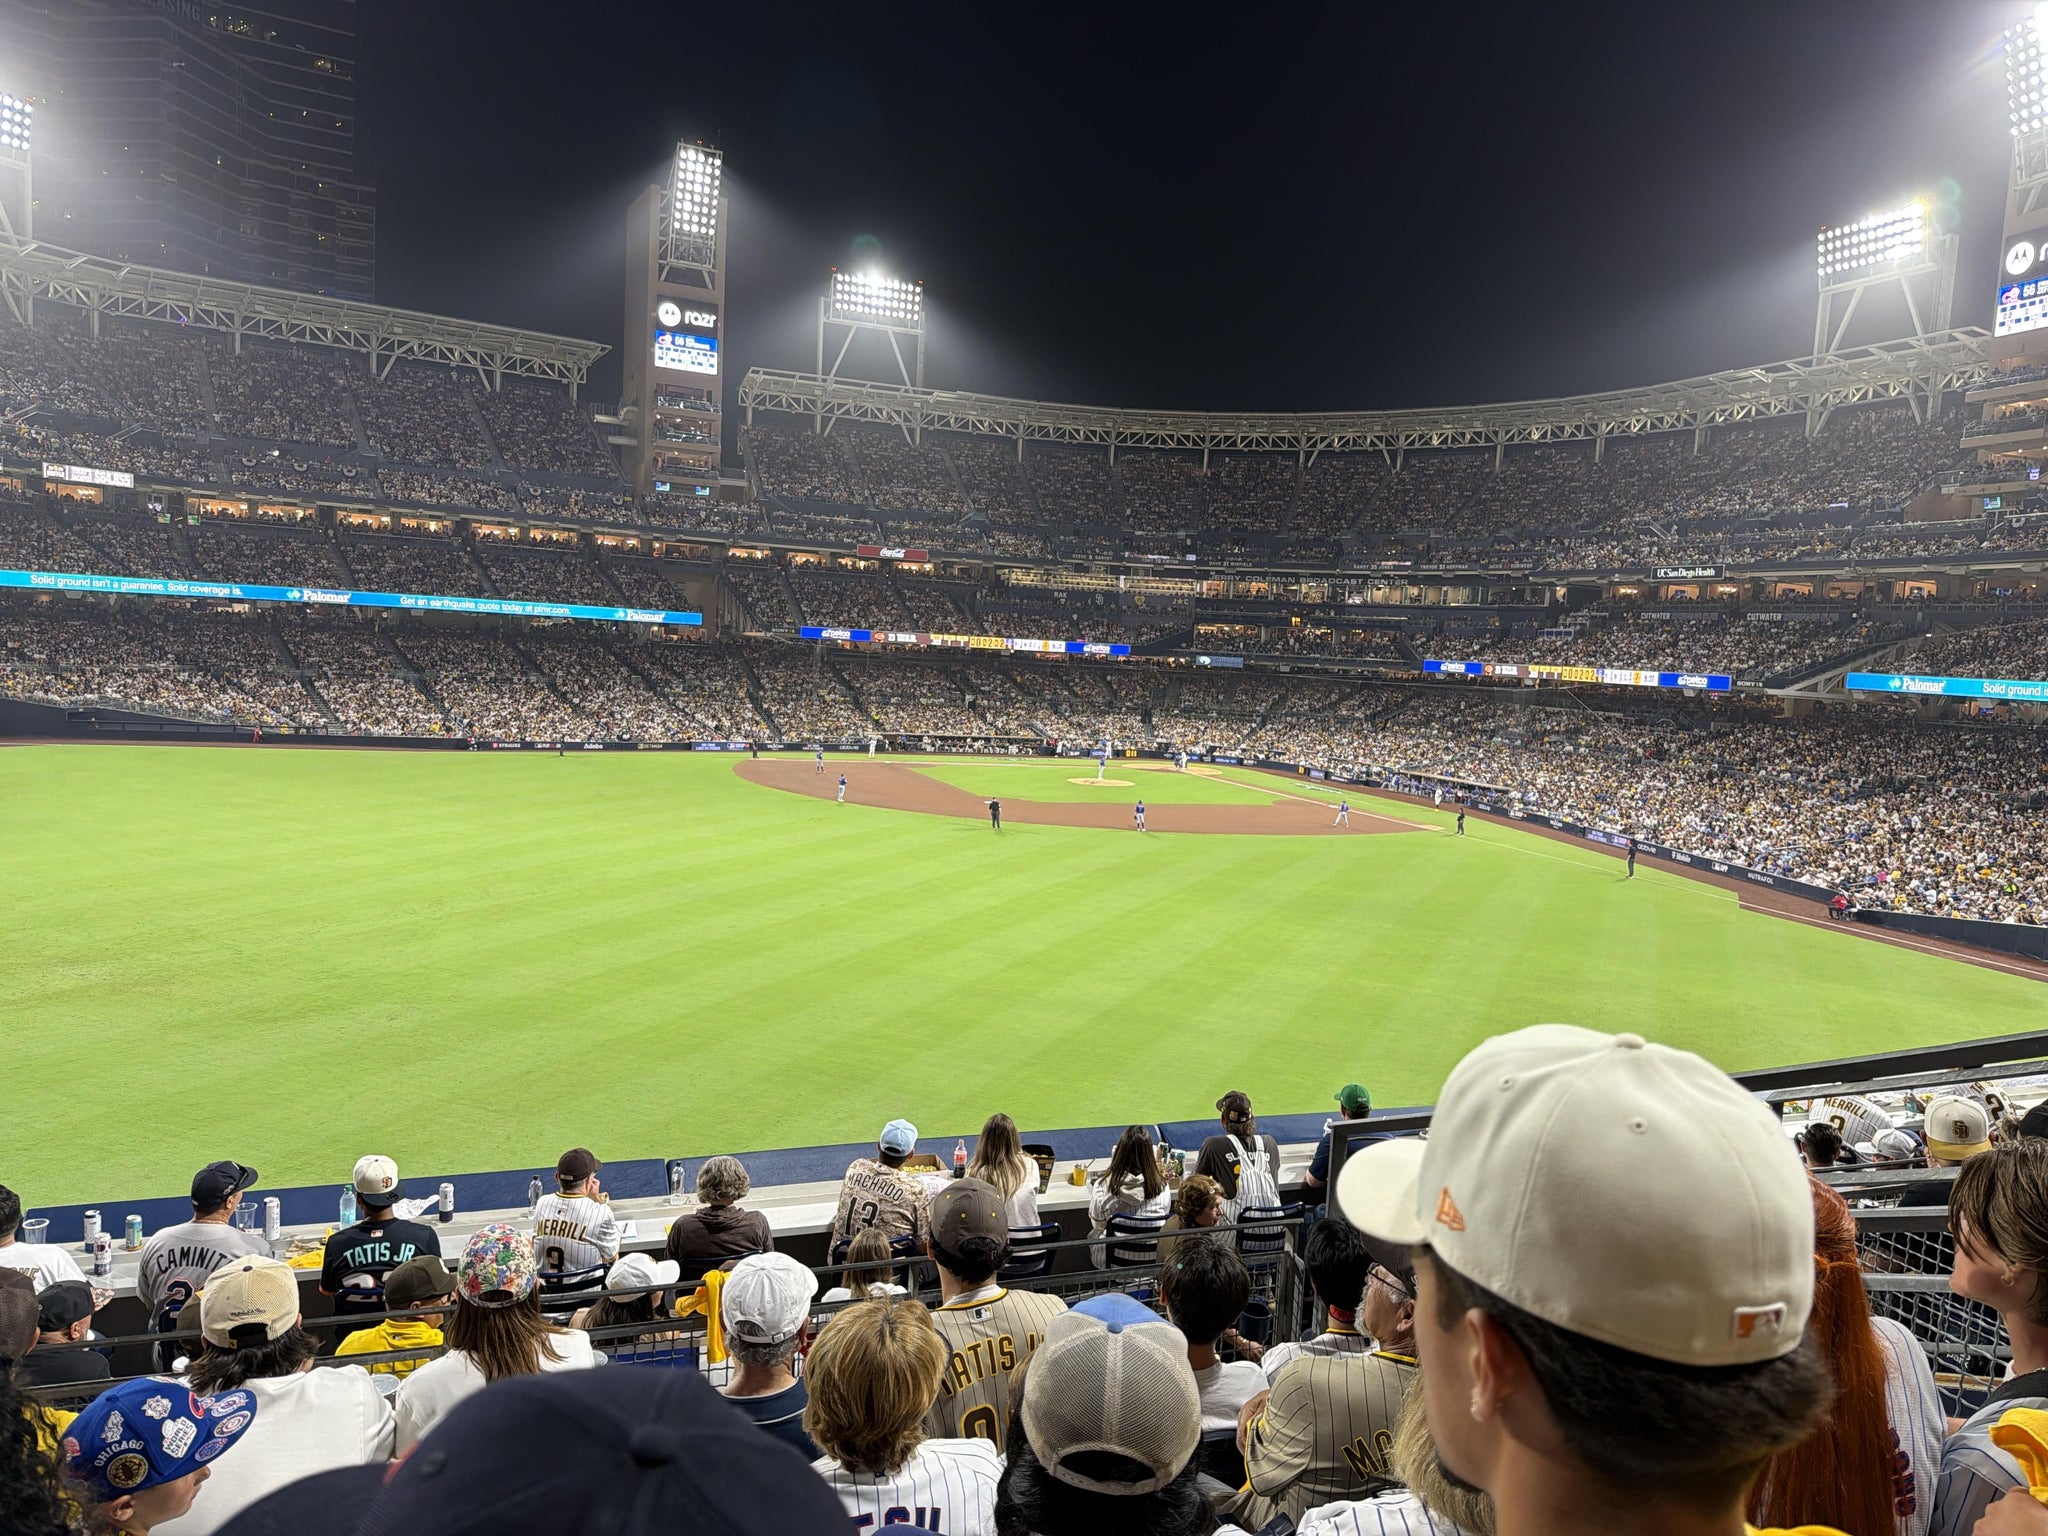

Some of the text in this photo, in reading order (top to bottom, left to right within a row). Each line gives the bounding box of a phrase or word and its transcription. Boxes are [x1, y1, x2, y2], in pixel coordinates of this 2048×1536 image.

[684, 311, 717, 329] razr
[880, 547, 906, 558] Coca-Cola
[1209, 573, 1241, 581] JERRY
[1245, 575, 1296, 583] COLEMAN
[1300, 577, 1364, 585] BROADCAST
[1679, 568, 1695, 578] Diego
[1695, 567, 1715, 577] Health
[30, 574, 55, 585] Solid
[57, 577, 91, 588] ground
[92, 578, 111, 588] isn't
[121, 581, 165, 592] guarantee.
[167, 582, 188, 592] Solid
[190, 585, 230, 596] coverage
[232, 586, 243, 595] is.
[303, 589, 350, 603] Palomar
[400, 596, 415, 606] Get
[429, 598, 475, 609] earthquake
[477, 601, 500, 611] quote
[502, 602, 523, 613] today
[525, 604, 533, 613] at
[626, 610, 665, 622] Palomar
[1640, 612, 1671, 620] CUTWATER
[1746, 612, 1783, 621] CUTWATER
[830, 630, 851, 638] petco
[1091, 645, 1111, 653] petco
[1448, 663, 1466, 671] petco
[1686, 676, 1708, 685] petco
[1902, 677, 1945, 692] Palomar
[1982, 682, 2005, 693] Solid
[2007, 685, 2042, 697] ground
[1676, 852, 1692, 864] Mobile
[1747, 871, 1774, 885] NUTRAFOL
[1824, 1097, 1869, 1120] MERRILL
[1952, 1119, 1970, 1138] SD
[847, 1172, 904, 1202] MACHADO
[844, 1195, 879, 1237] 13
[536, 1218, 588, 1241] MERRILL
[156, 1246, 235, 1274] CAMINIT
[343, 1241, 416, 1268] TATIS JR
[546, 1245, 565, 1285] 3
[164, 1419, 187, 1451] WORLD
[170, 1422, 194, 1456] SERIES
[94, 1440, 145, 1467] CHICAGO
